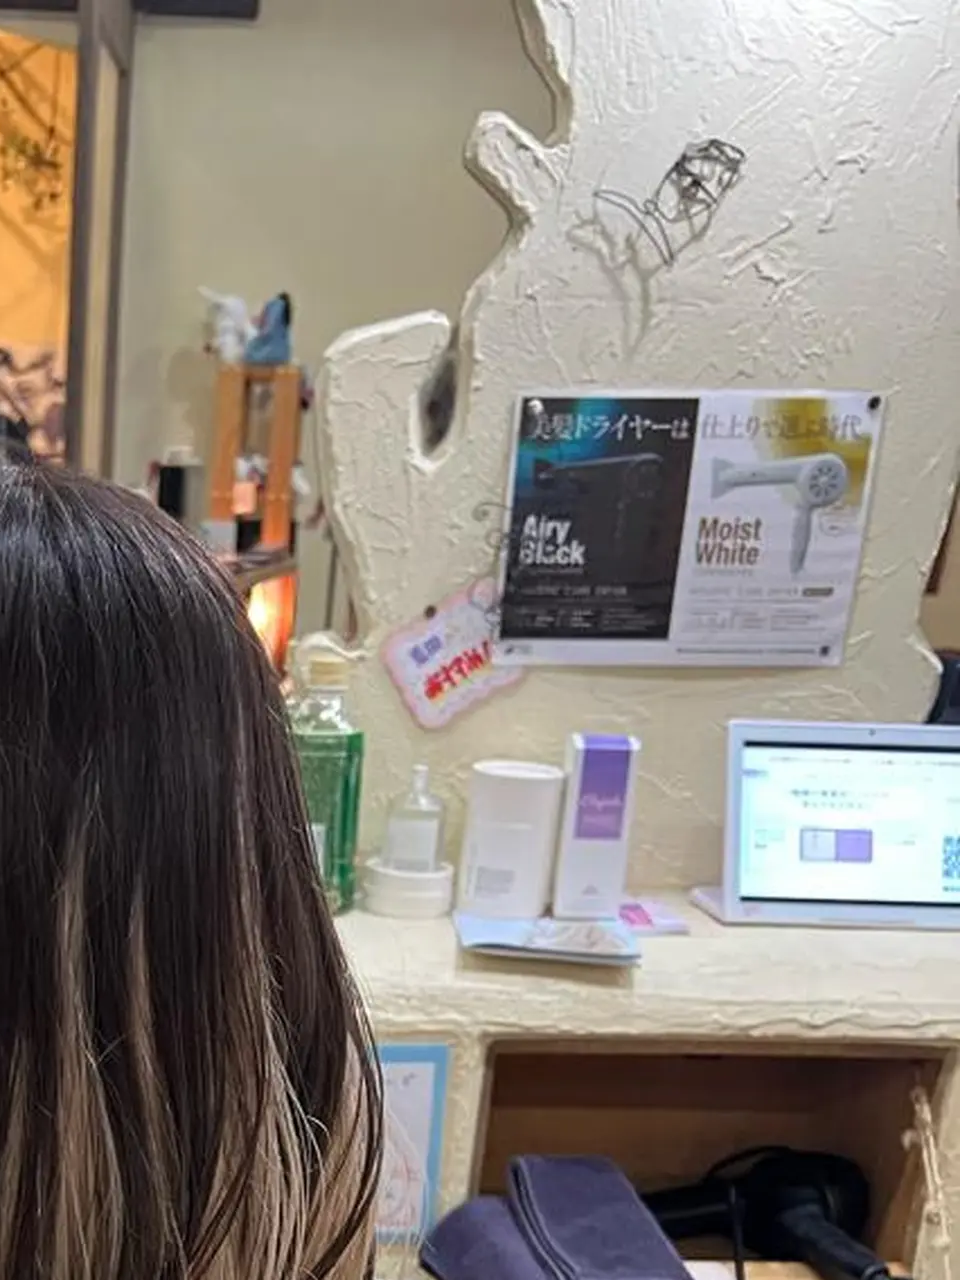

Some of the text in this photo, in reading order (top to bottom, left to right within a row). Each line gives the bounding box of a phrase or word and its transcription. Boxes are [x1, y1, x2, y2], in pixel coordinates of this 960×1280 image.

[522, 513, 572, 545] Airy
[697, 515, 763, 541] Moist
[519, 538, 586, 566] Black
[694, 540, 760, 566] White
